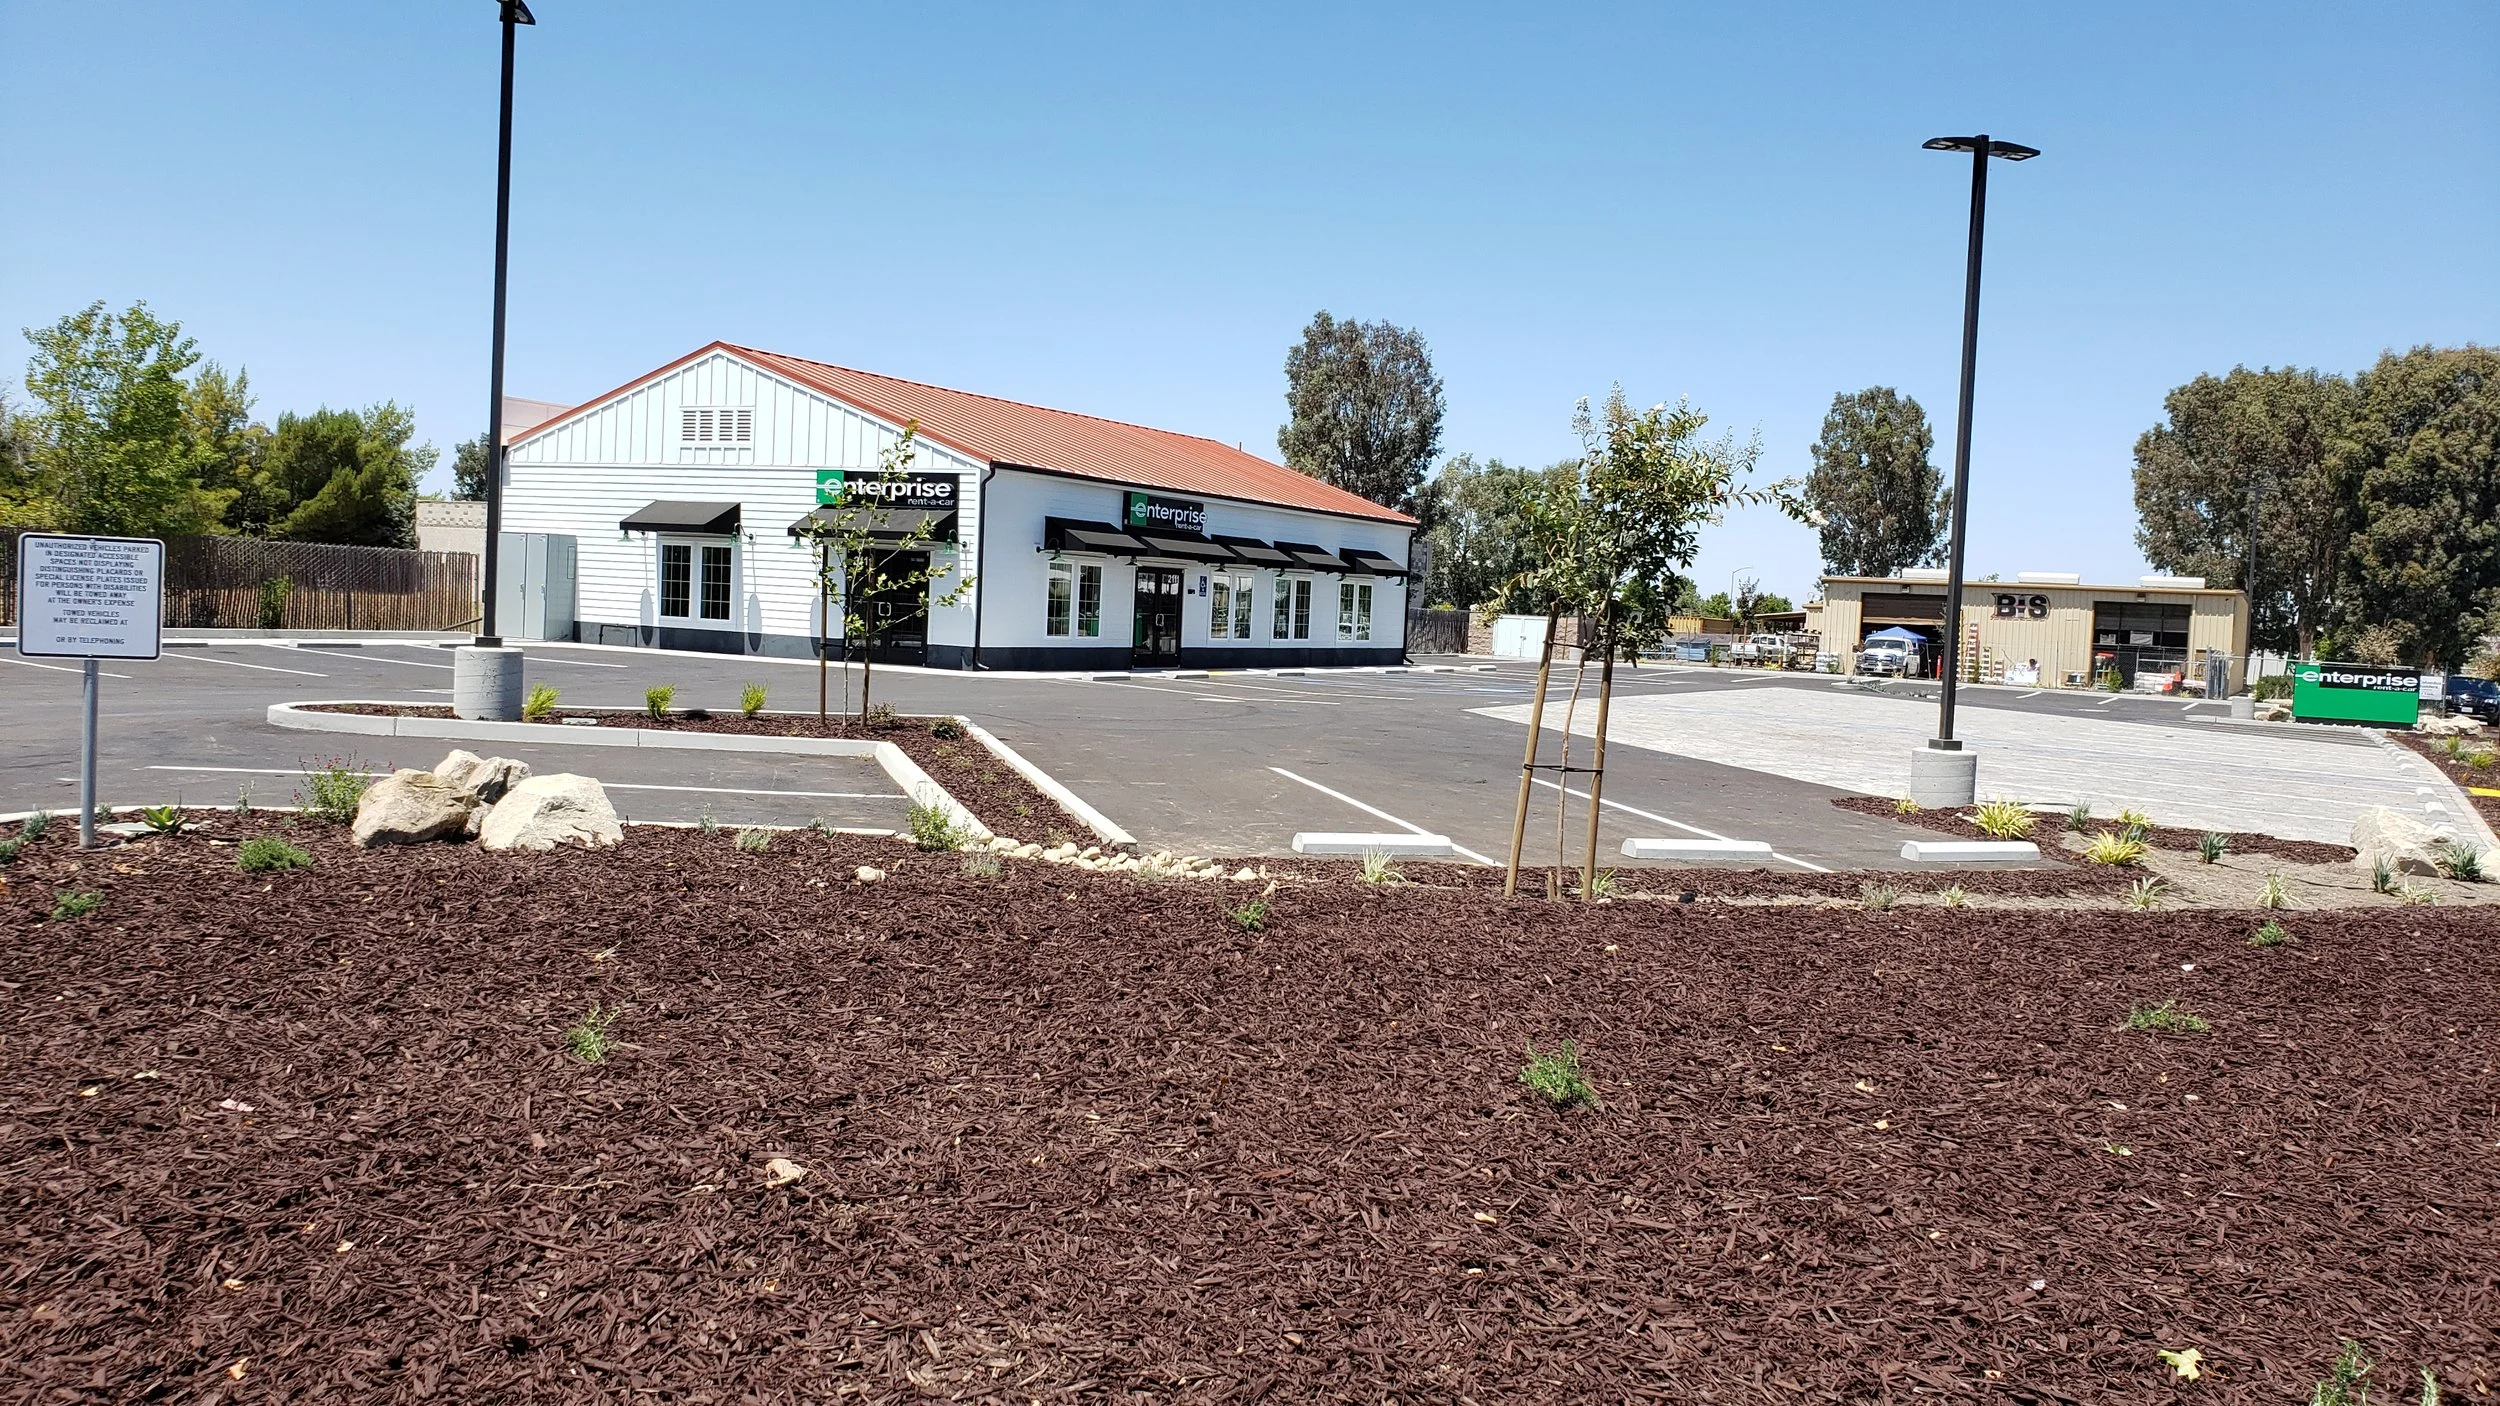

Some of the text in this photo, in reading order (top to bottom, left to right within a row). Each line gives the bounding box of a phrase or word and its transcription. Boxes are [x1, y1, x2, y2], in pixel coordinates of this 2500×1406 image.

[817, 478, 951, 501] enterprise
[907, 498, 955, 506] rent-a-car
[1131, 502, 1208, 525] enterprise
[1175, 523, 1202, 531] rent-a-car
[35, 542, 87, 550] UNAUTHORIZED
[89, 544, 121, 552] VEHICLES
[54, 551, 95, 559] DESIGNATED
[94, 560, 134, 568] DISPLAYING
[39, 565, 94, 574] DISTINGUISHING
[96, 568, 132, 576] PLACARDS
[35, 573, 62, 581] SPECIAL
[65, 574, 94, 582] LICENSE
[103, 584, 147, 592] DISABILITIES
[79, 637, 125, 645] TELEPHONING
[2296, 670, 2418, 687] enterprise
